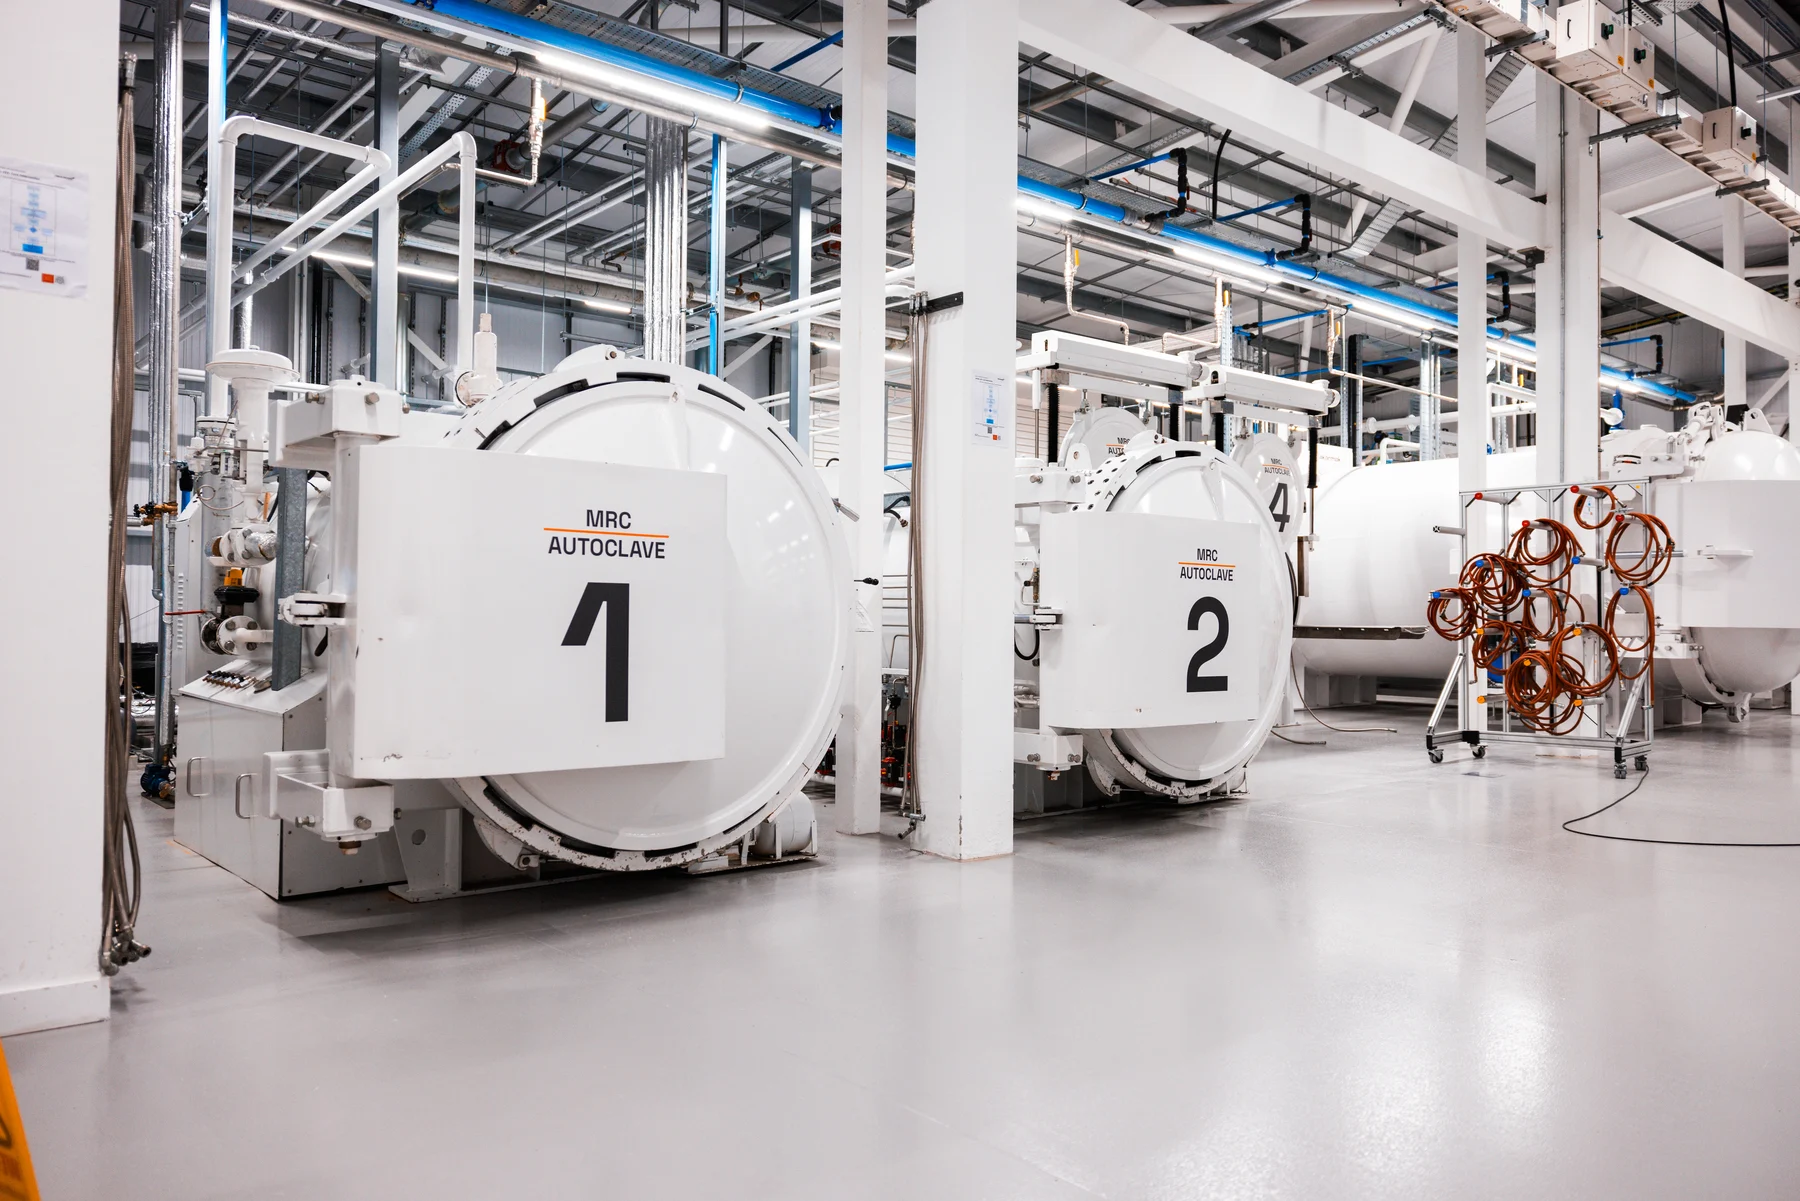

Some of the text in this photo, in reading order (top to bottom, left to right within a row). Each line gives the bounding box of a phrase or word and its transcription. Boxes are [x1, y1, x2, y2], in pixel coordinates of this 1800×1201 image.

[1108, 447, 1125, 455] AUTO
[1268, 482, 1291, 532] 4
[586, 509, 632, 529] MRC
[548, 536, 666, 559] AUTOCLAVE
[1196, 548, 1218, 561] MRC
[1179, 566, 1234, 581] AUTOCLAVE
[561, 582, 630, 722] 1
[1186, 596, 1229, 692] 2
